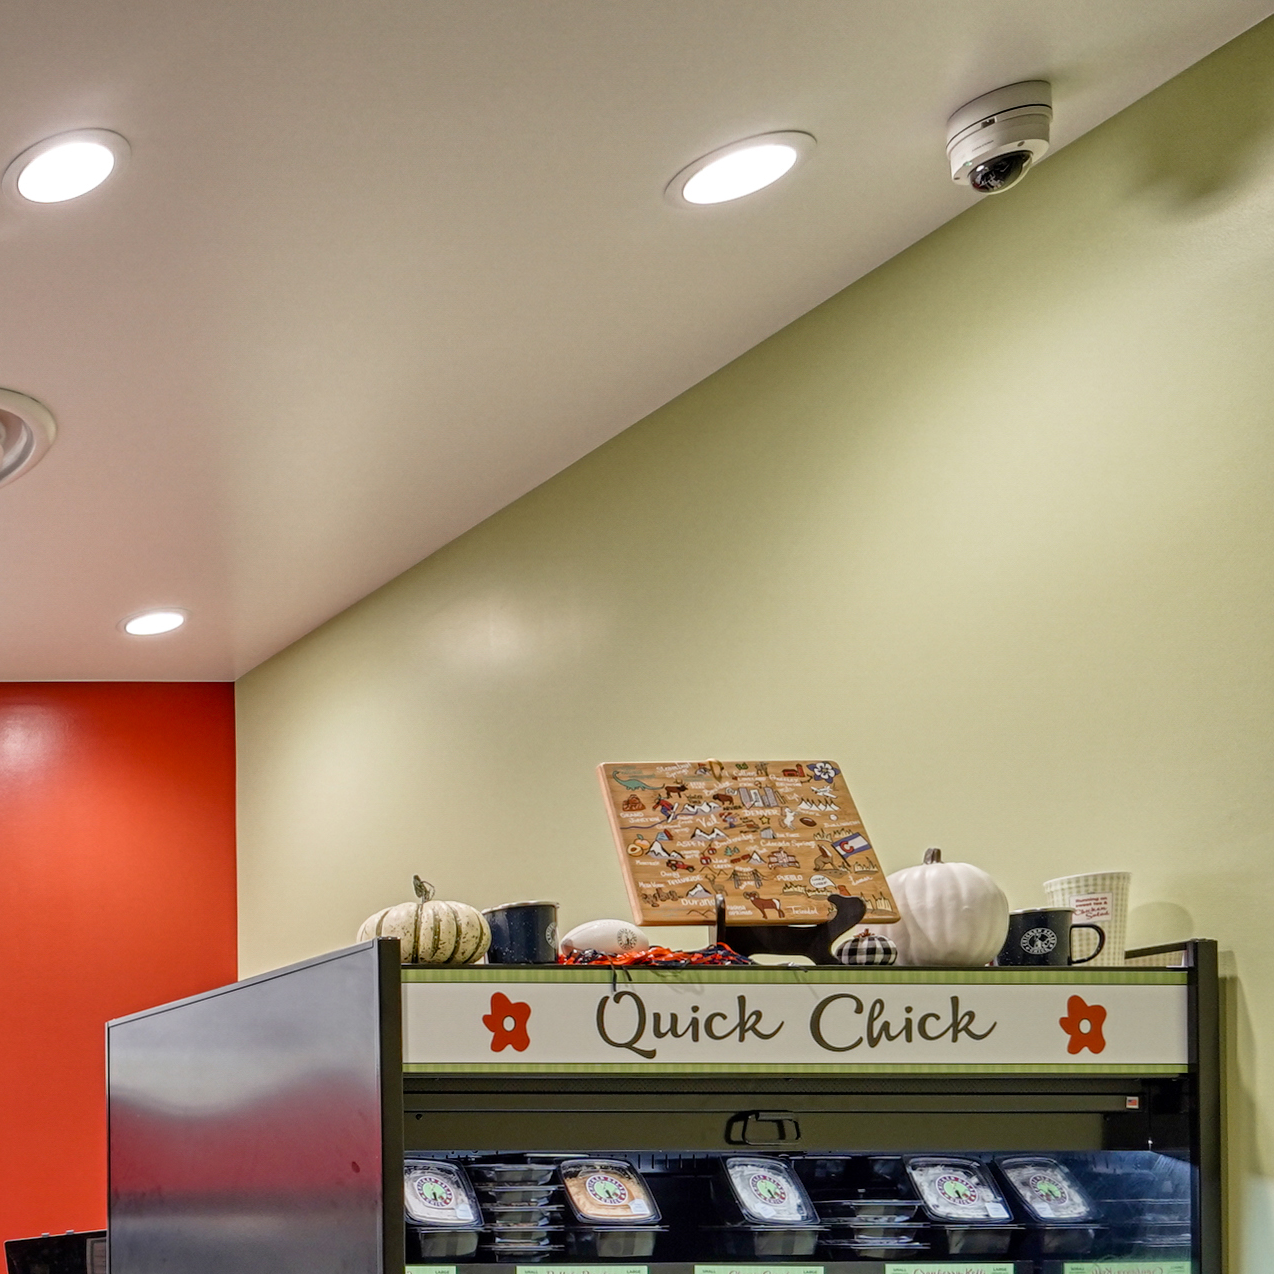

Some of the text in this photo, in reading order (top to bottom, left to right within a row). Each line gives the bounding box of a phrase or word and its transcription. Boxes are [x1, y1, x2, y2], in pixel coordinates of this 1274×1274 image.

[743, 809, 780, 817] DENVER
[596, 991, 997, 1059] Quick Chick
